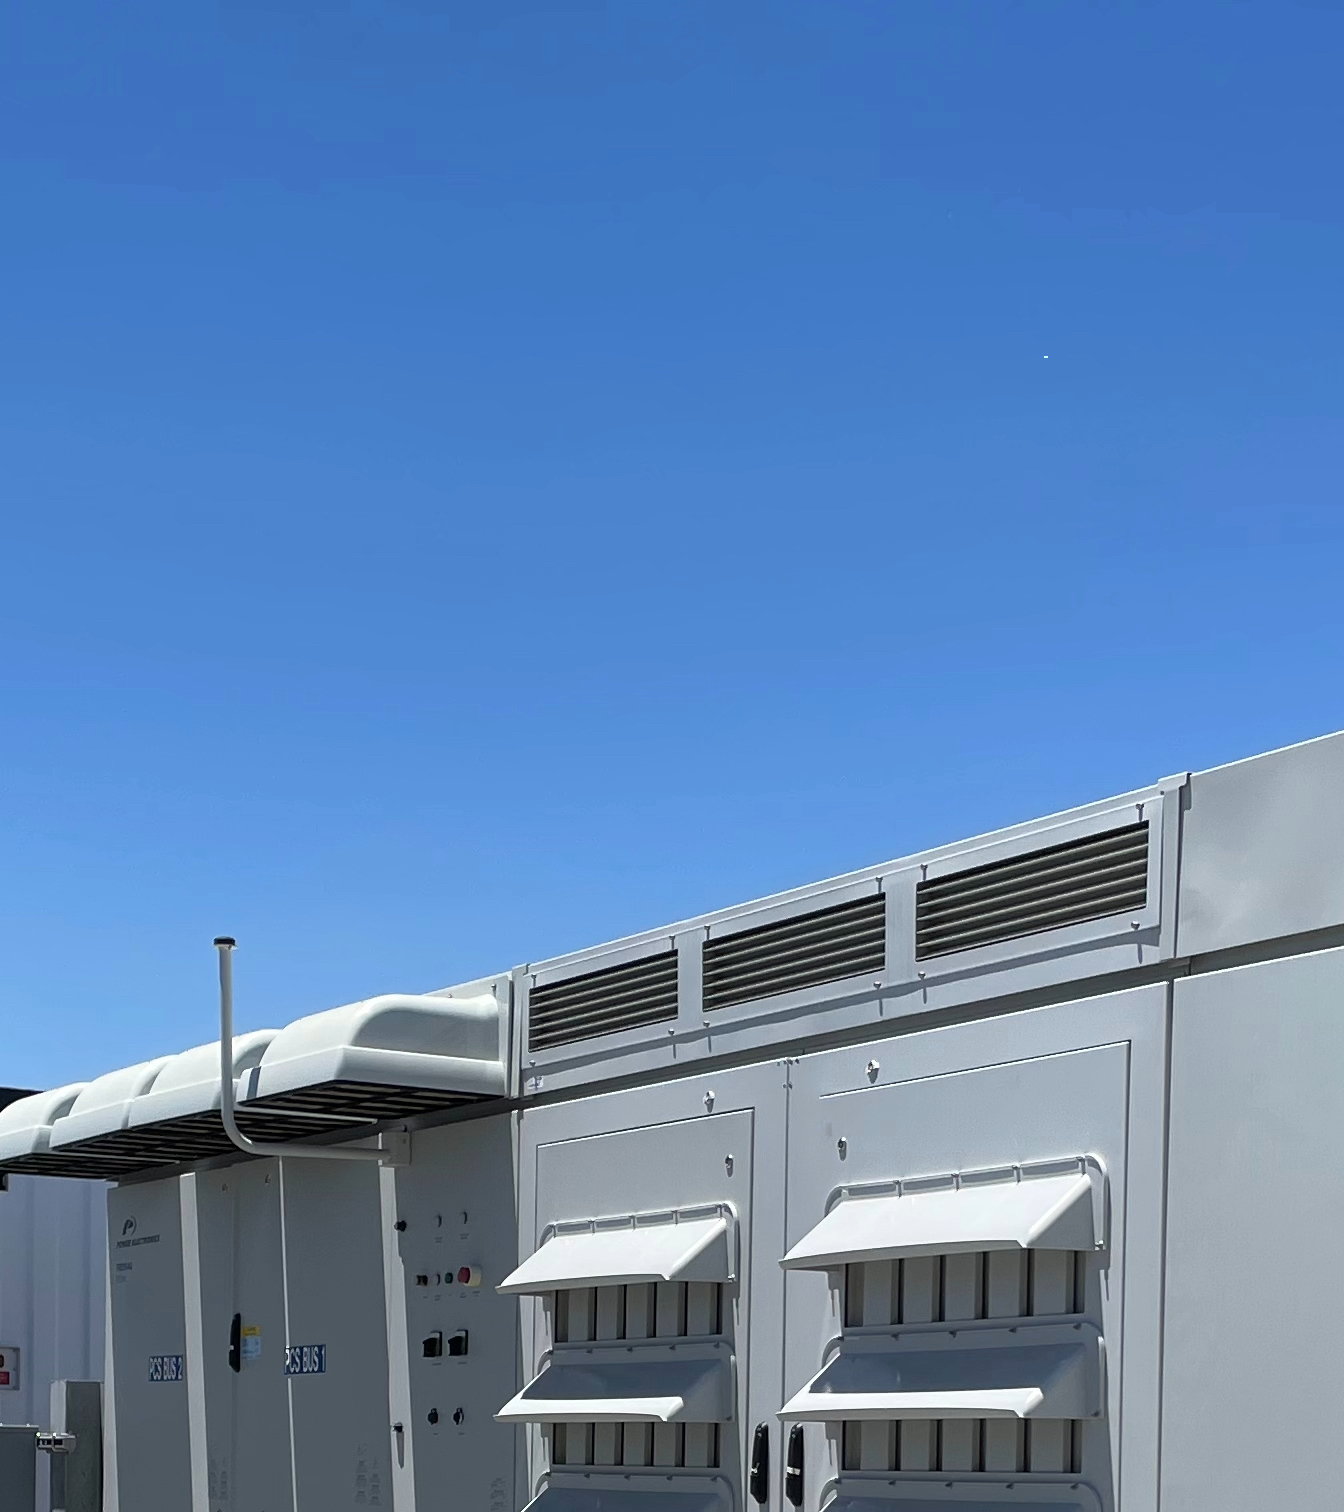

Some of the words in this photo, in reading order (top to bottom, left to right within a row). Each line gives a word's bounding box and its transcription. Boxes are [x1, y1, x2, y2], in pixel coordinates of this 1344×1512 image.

[149, 1357, 162, 1380] PCS
[163, 1357, 177, 1380] BUS
[178, 1357, 183, 1380] 2
[285, 1347, 301, 1373] PCS
[302, 1346, 319, 1372] BUS
[321, 1347, 325, 1371] 1
